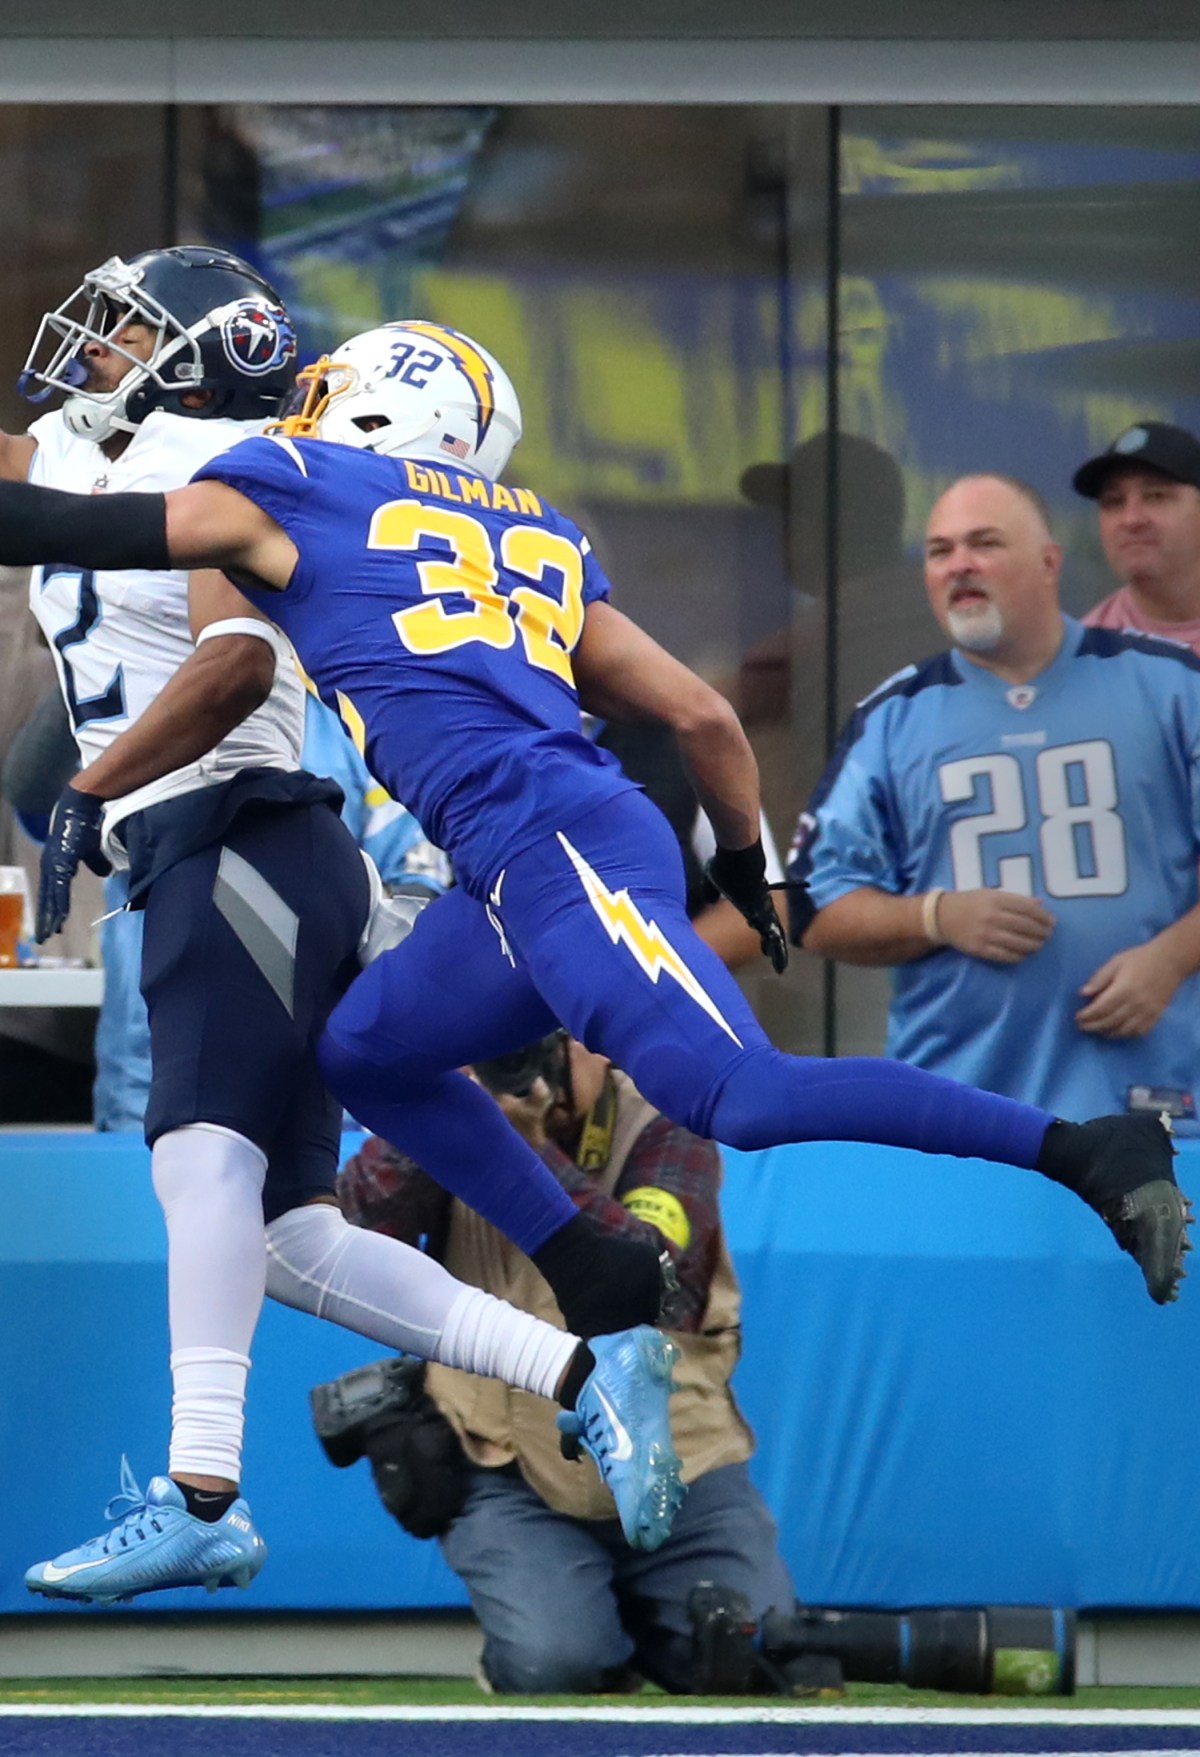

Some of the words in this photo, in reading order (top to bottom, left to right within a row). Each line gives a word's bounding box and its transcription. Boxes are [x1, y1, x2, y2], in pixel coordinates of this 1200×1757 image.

[385, 342, 444, 390] 32
[404, 460, 543, 517] GILMAN
[40, 562, 129, 734] 2
[367, 498, 585, 690] 32
[938, 737, 1130, 898] 28
